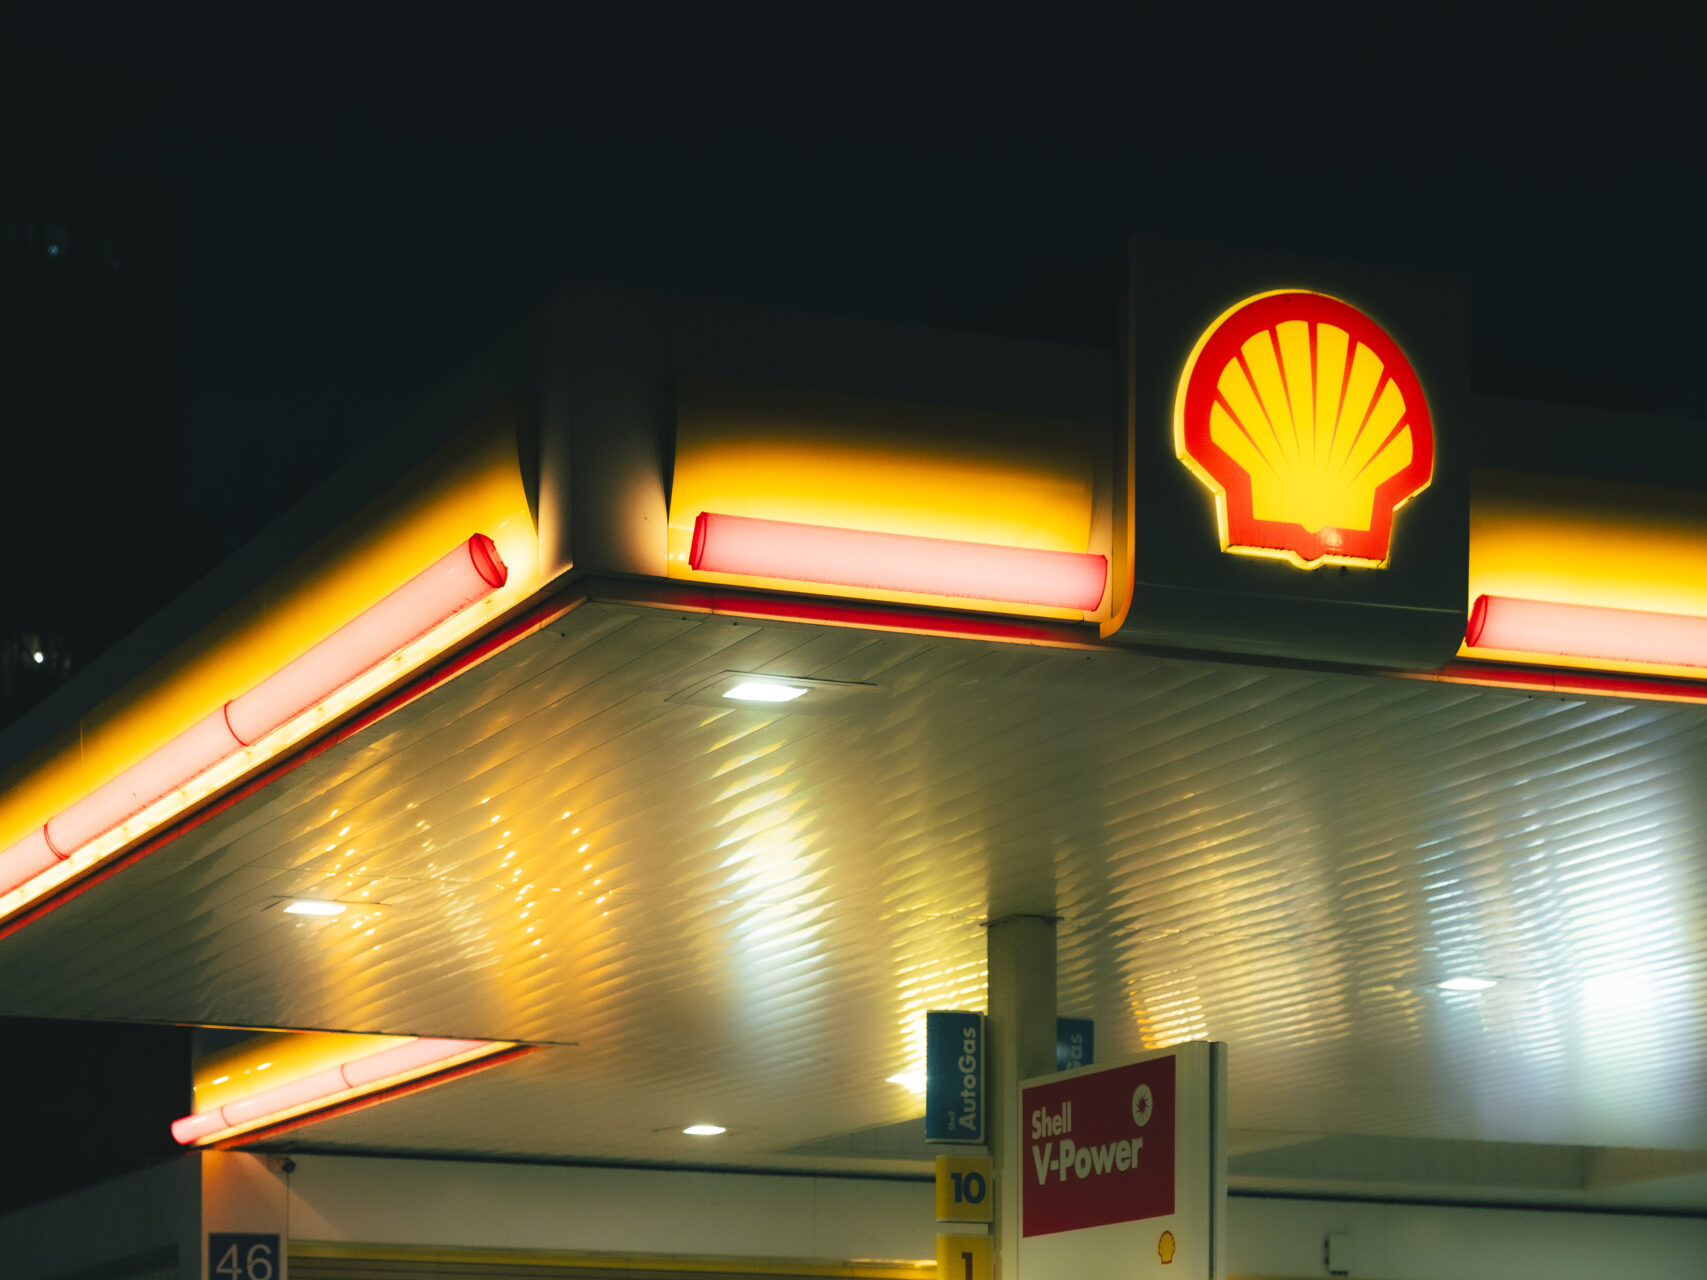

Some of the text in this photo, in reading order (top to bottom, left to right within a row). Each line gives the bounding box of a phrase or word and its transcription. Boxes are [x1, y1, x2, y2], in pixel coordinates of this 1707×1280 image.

[958, 1027, 977, 1131] AutoGas
[948, 1111, 956, 1130] Shell
[1031, 1100, 1072, 1140] Shell
[1032, 1136, 1143, 1186] V-Power
[950, 1171, 986, 1205] 10
